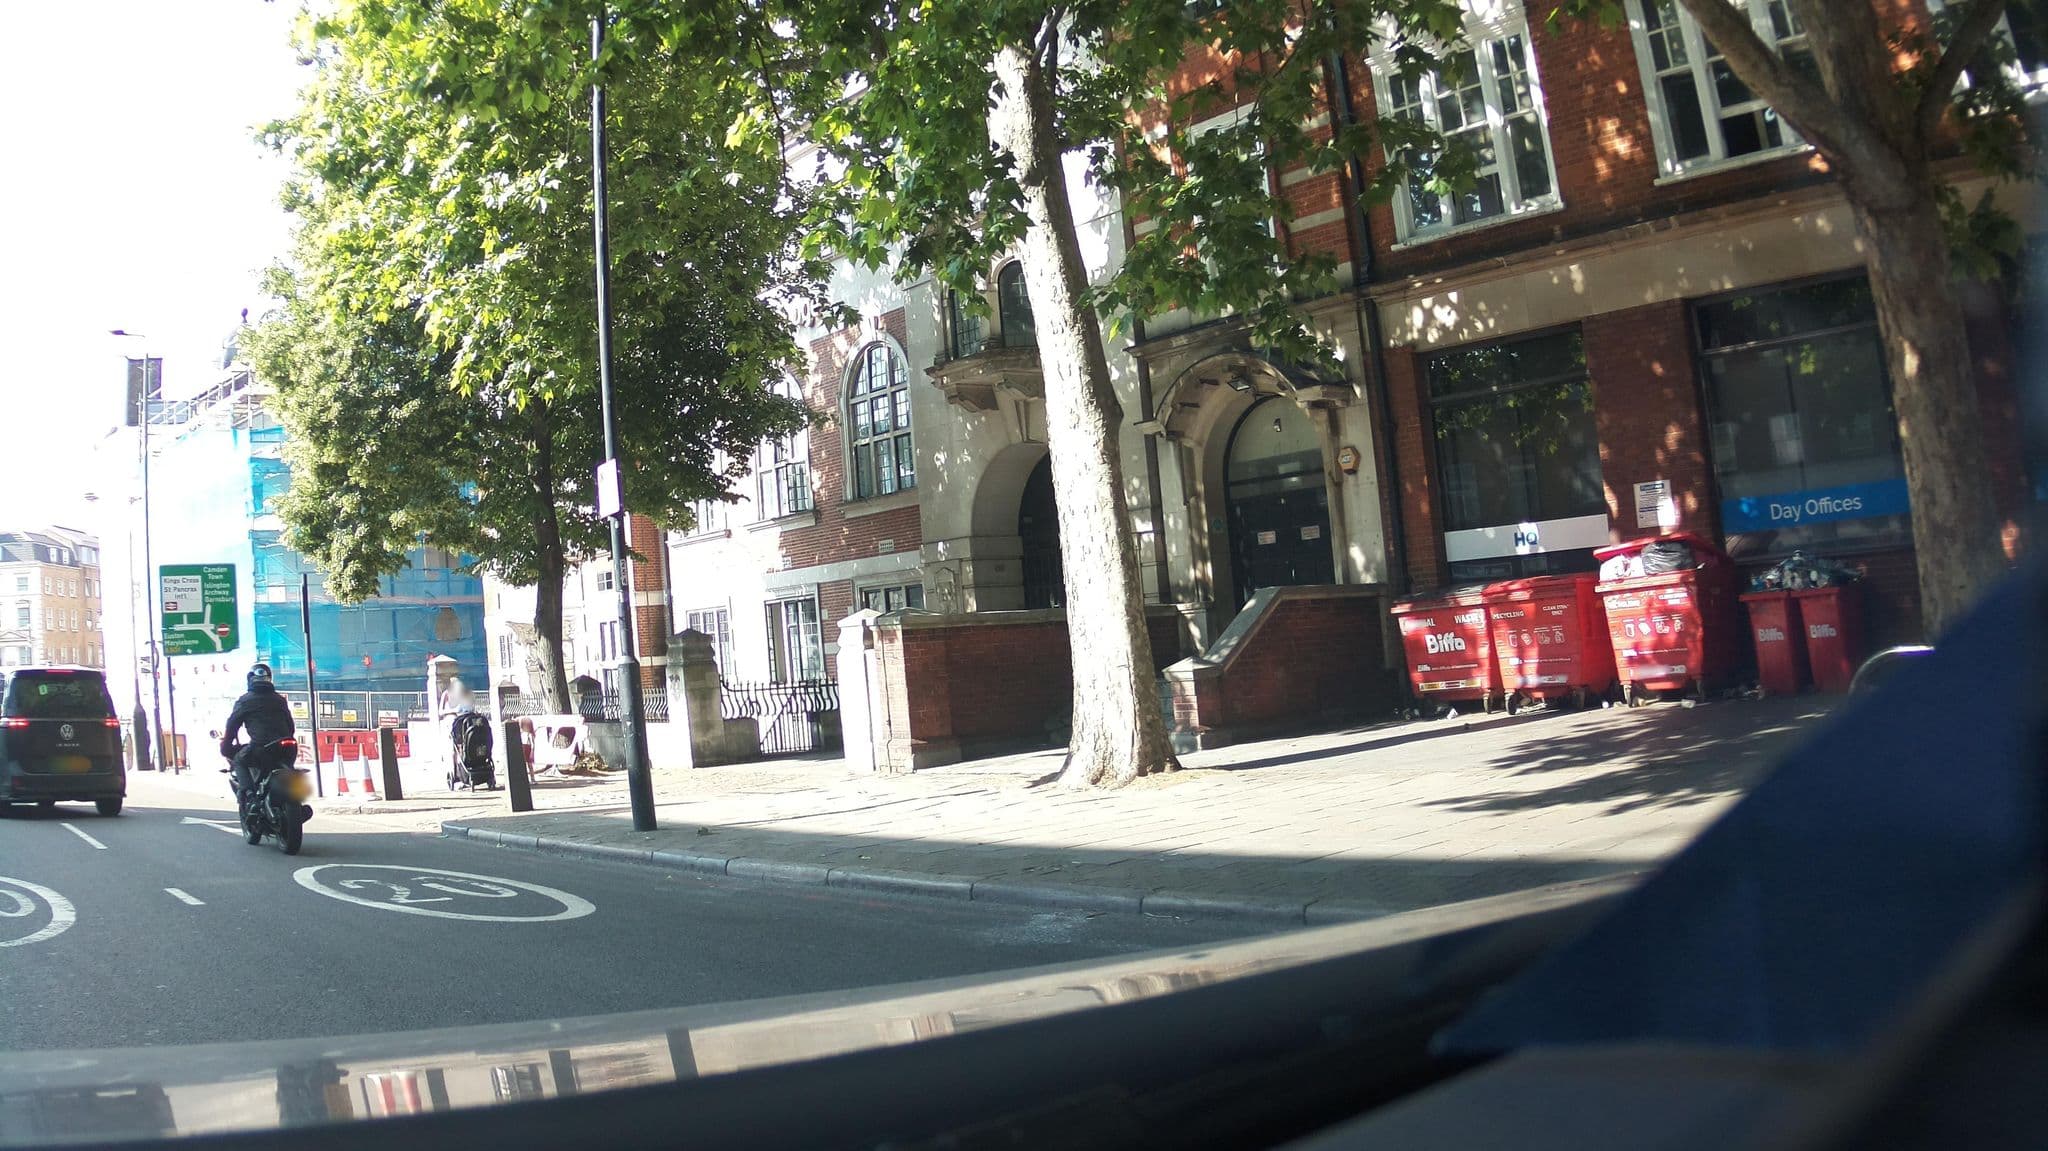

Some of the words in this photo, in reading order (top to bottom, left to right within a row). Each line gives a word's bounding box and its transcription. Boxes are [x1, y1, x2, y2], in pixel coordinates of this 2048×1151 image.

[1770, 503, 1801, 522] Day
[1805, 496, 1863, 515] Offices
[1514, 532, 1538, 547] HQ
[1758, 627, 1785, 643] Biffa
[1809, 624, 1837, 639] Biffa
[1424, 632, 1467, 655] Biffa
